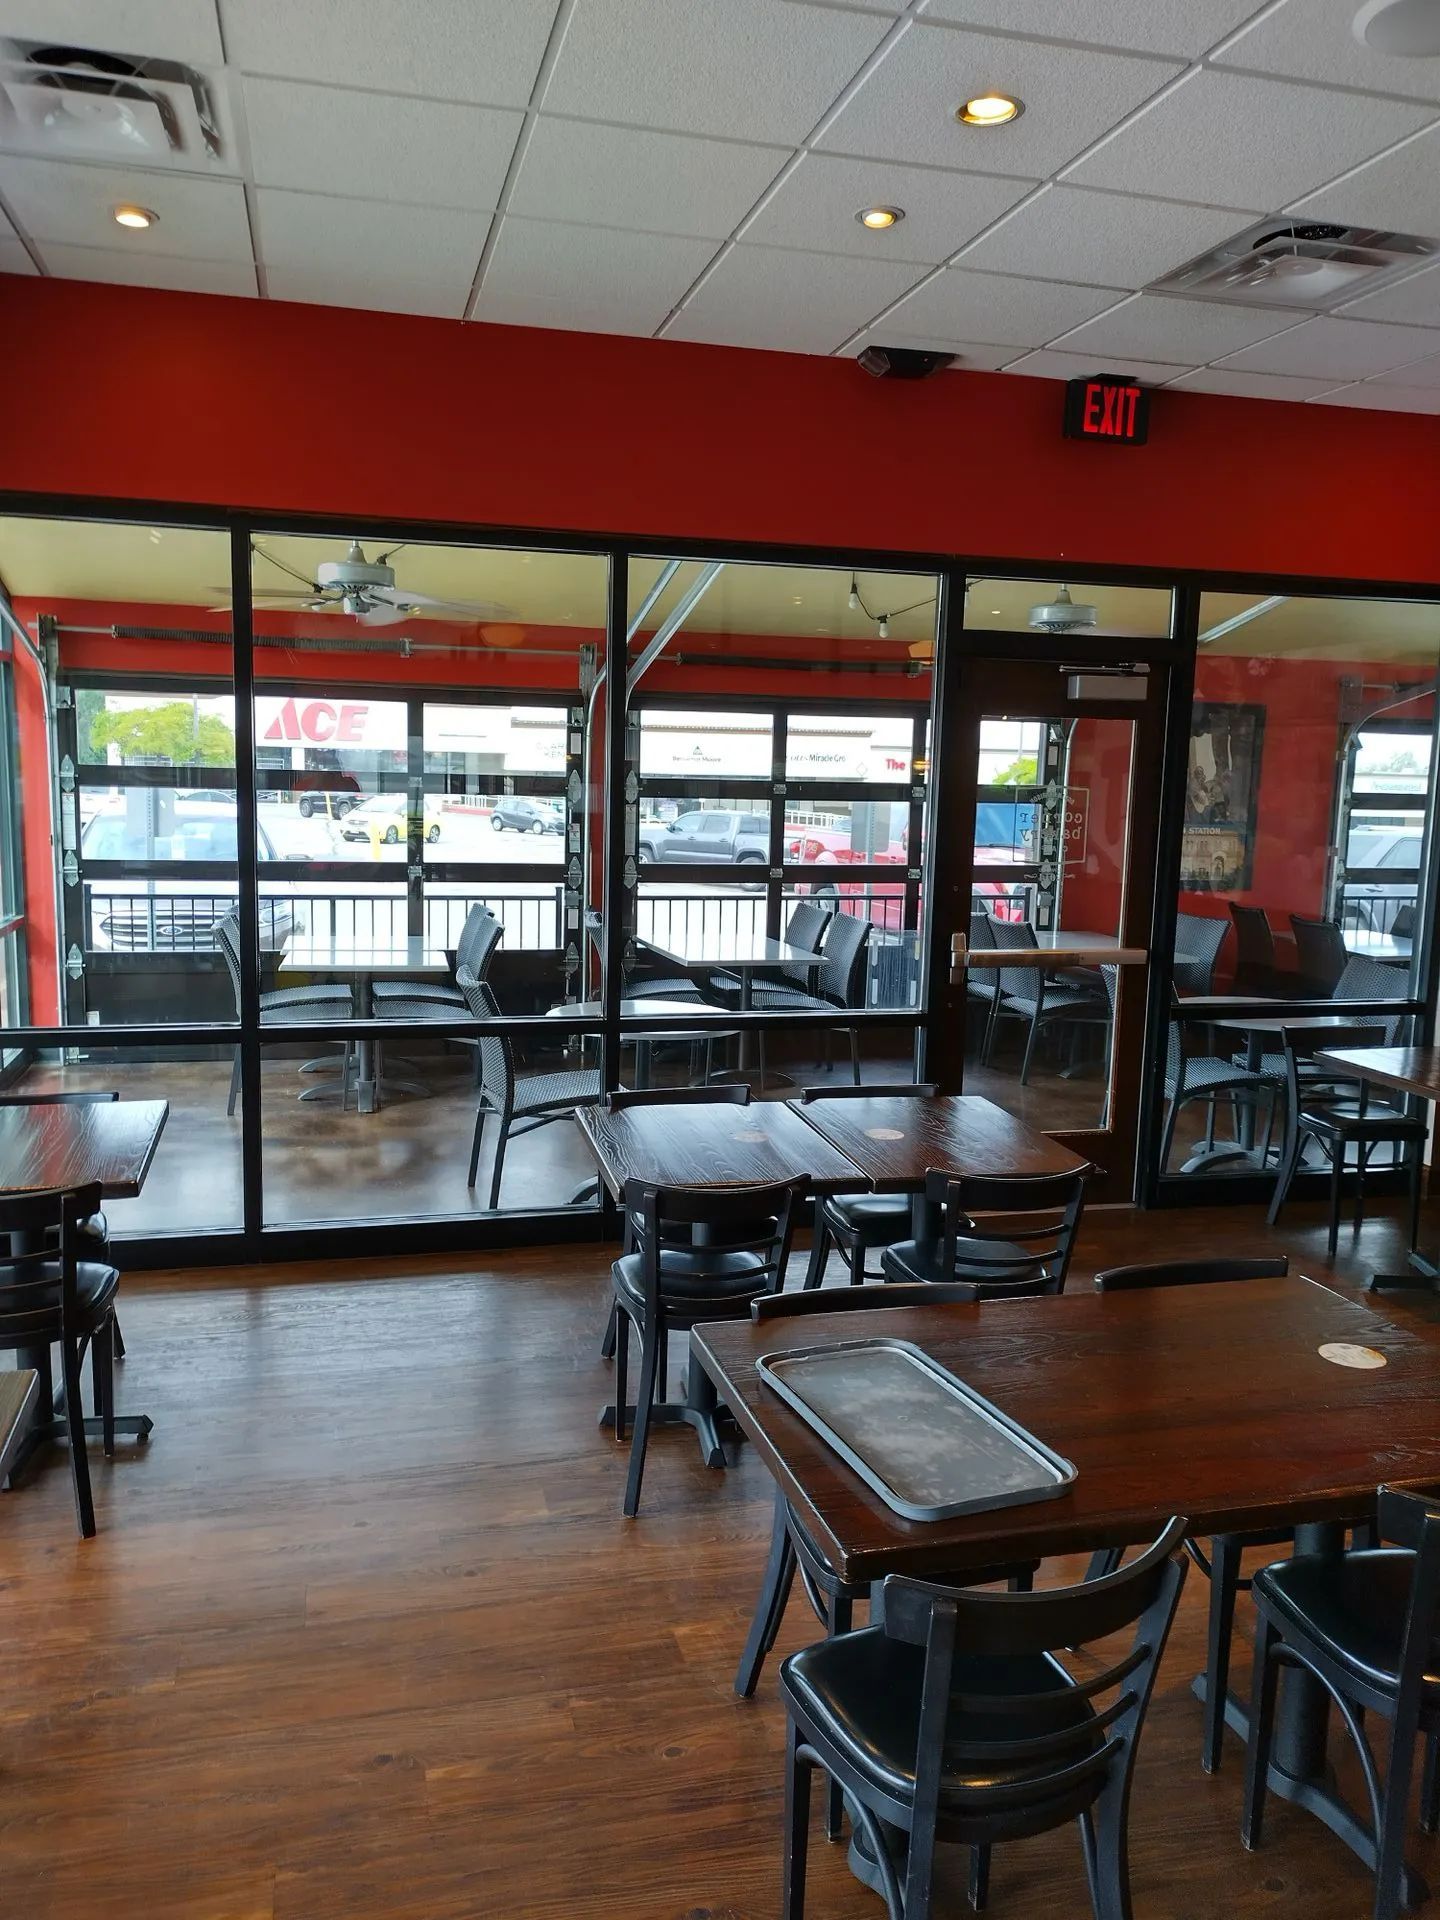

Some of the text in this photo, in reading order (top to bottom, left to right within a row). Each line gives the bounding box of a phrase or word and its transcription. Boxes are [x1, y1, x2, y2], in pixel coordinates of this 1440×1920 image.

[1083, 383, 1141, 437] EXIT
[264, 697, 369, 741] ACE
[885, 758, 906, 771] The
[1188, 827, 1221, 835] STATION
